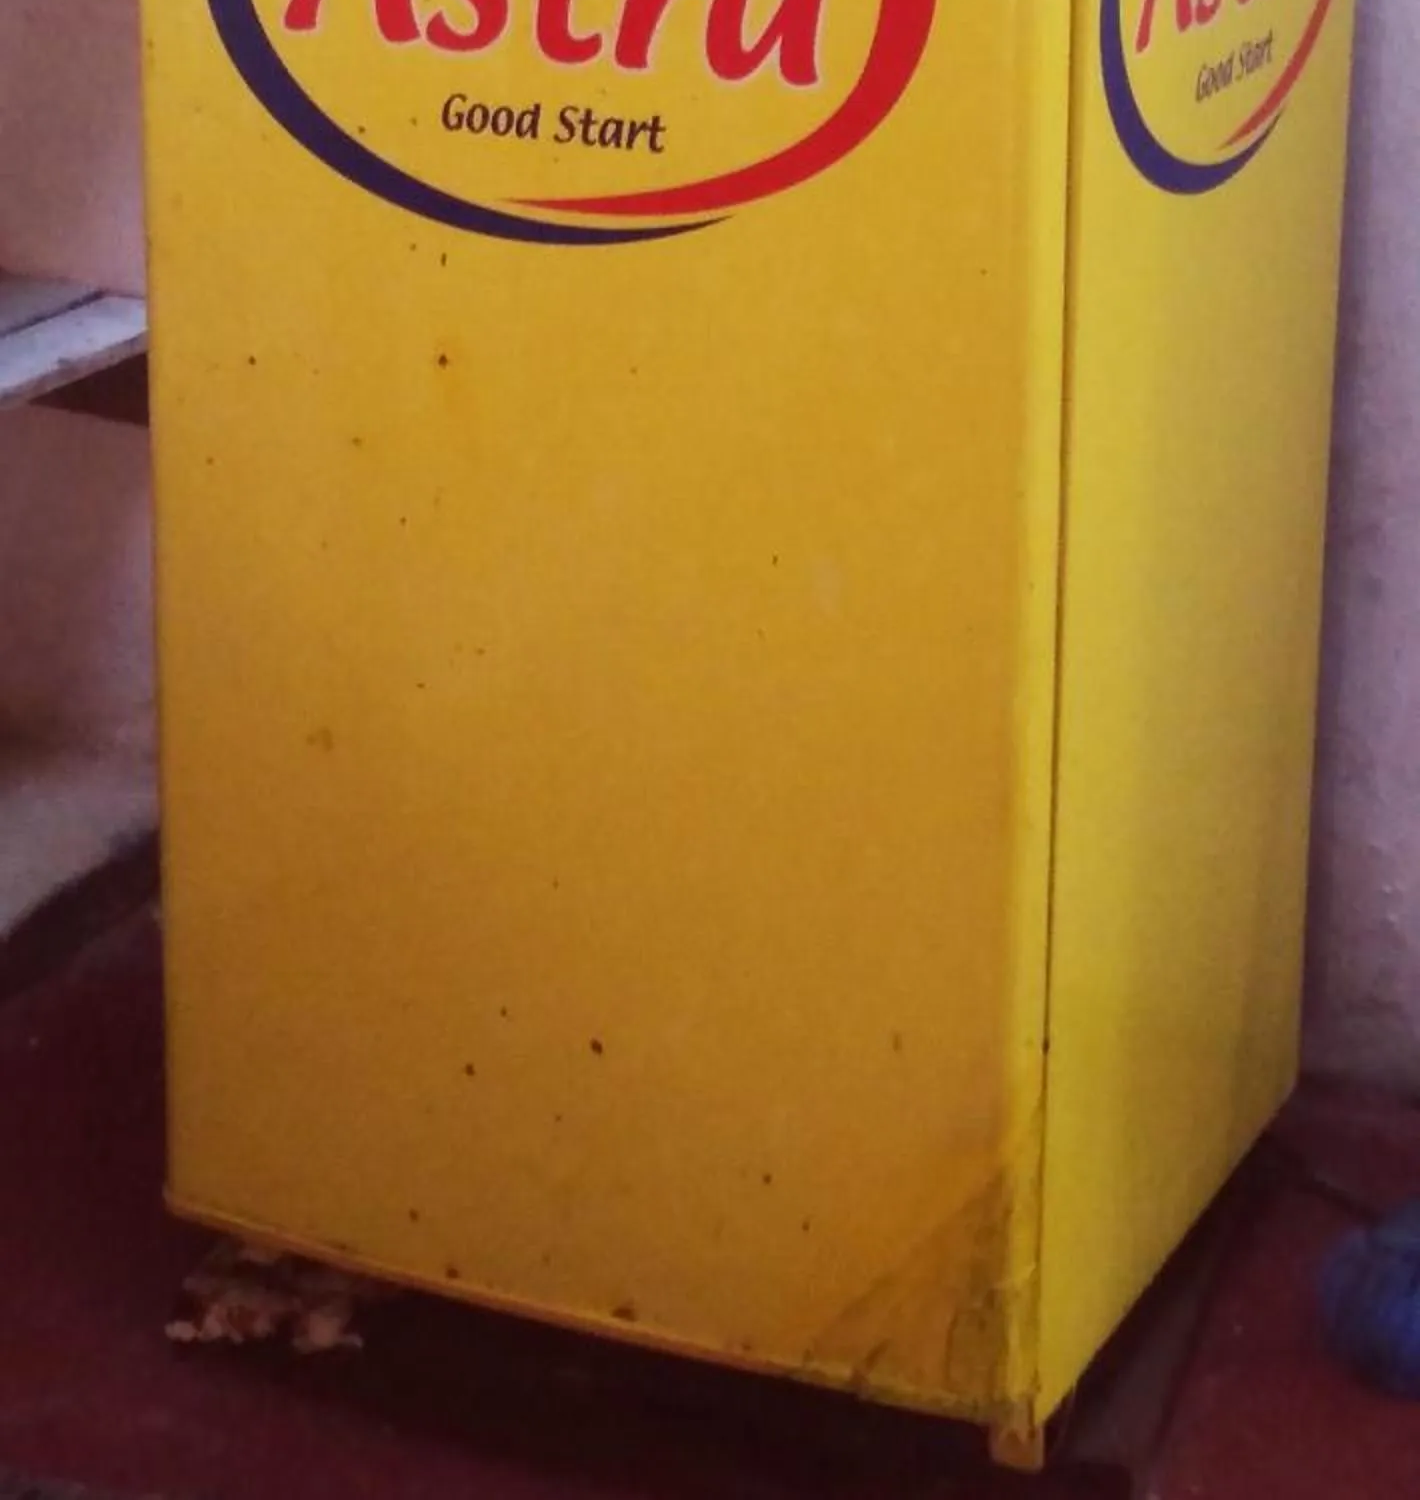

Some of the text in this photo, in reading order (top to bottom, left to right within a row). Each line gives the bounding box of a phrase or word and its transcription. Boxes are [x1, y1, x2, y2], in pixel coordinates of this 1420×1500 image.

[1195, 27, 1273, 104] Good Start
[441, 93, 667, 154] Good Start
